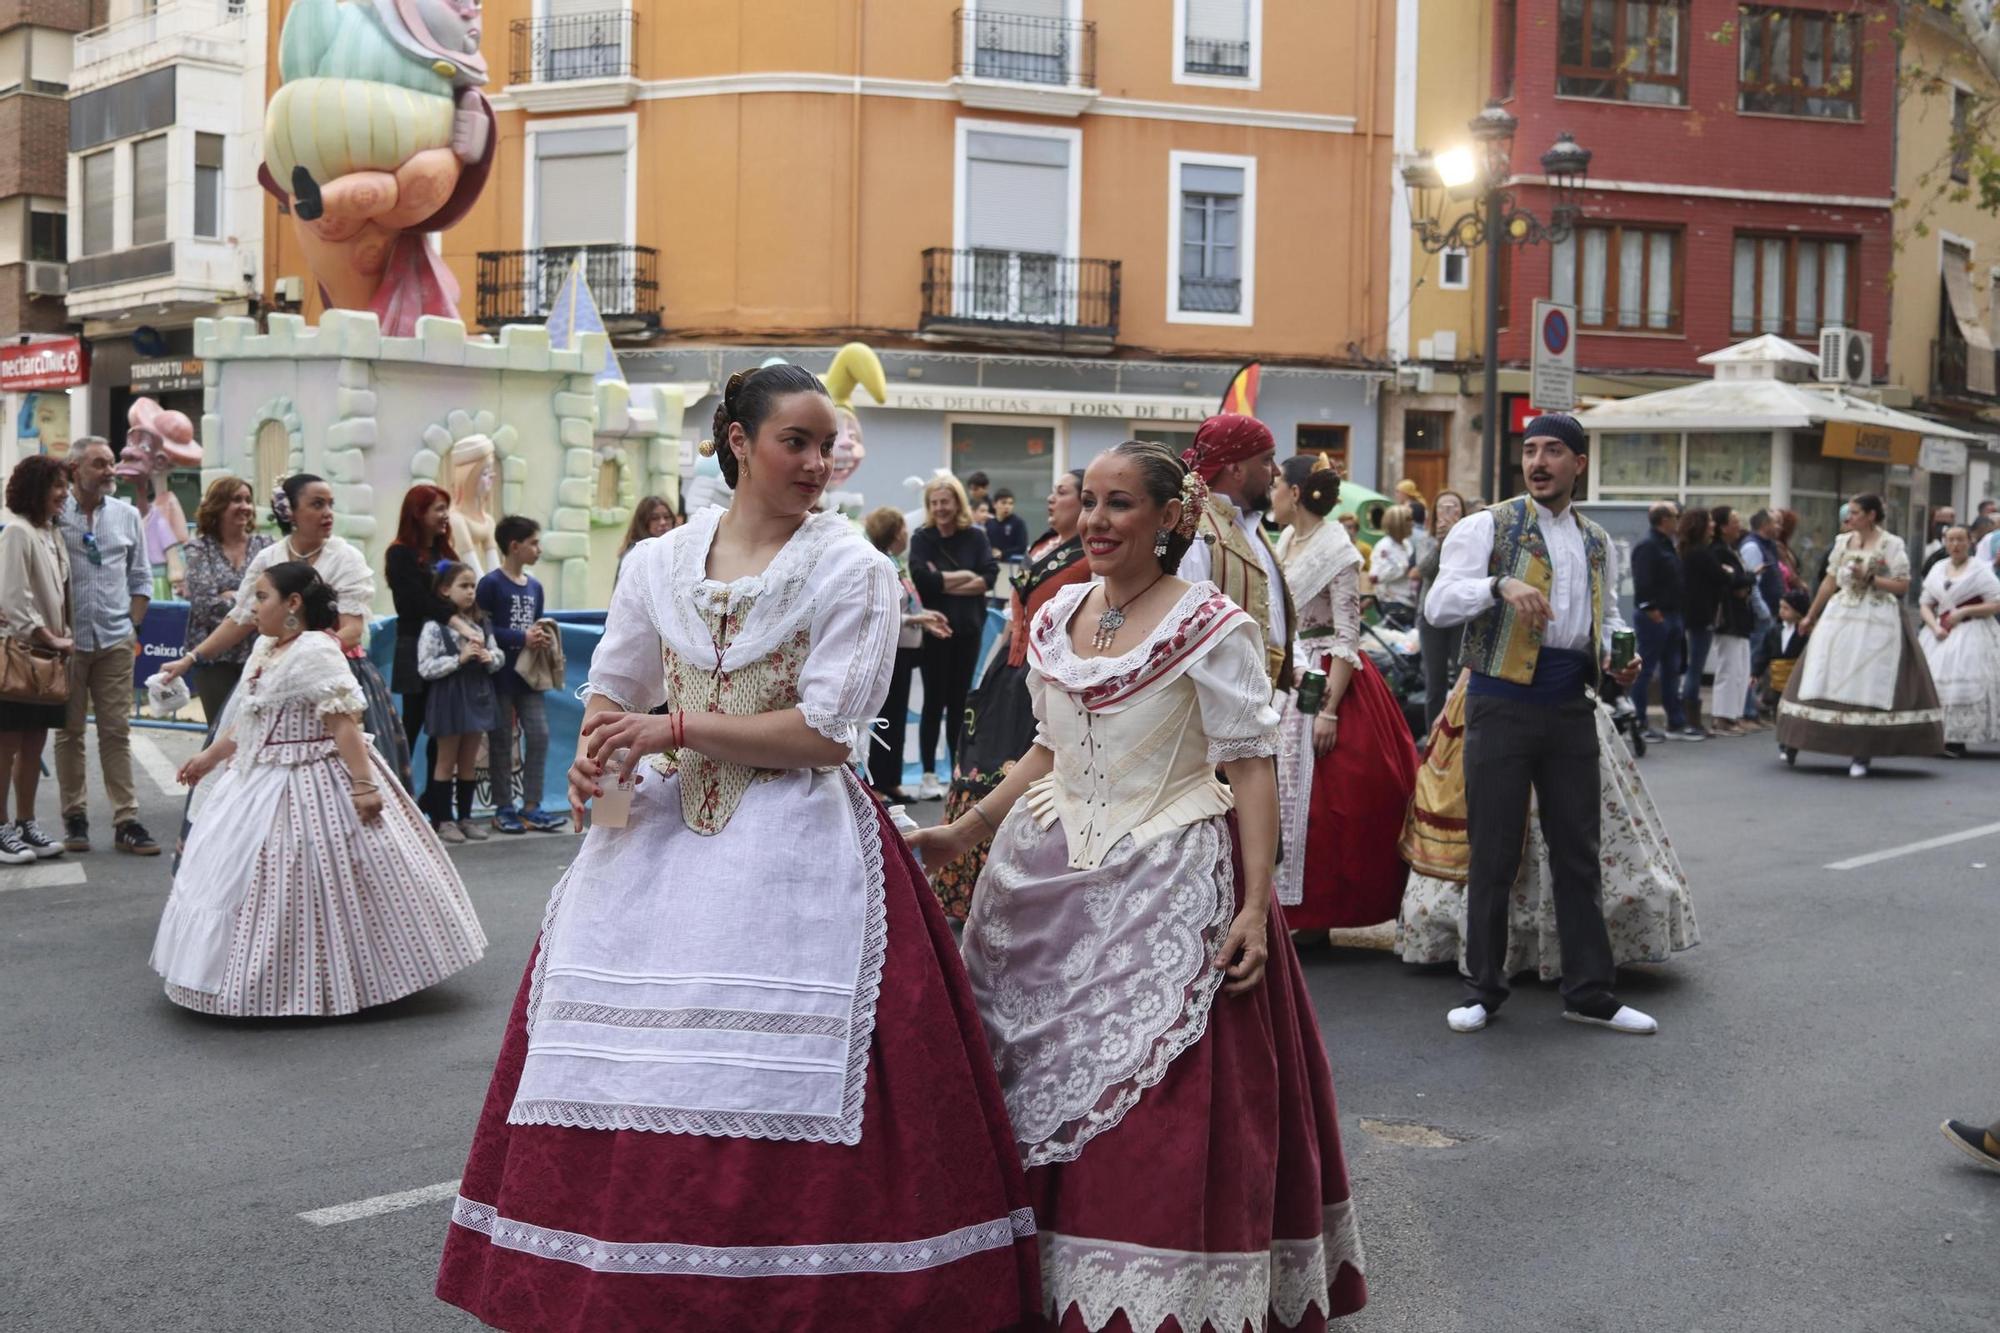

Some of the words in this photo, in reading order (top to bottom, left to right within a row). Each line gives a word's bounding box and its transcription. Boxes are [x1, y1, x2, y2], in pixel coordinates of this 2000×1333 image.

[131, 362, 170, 379] TENEMOS
[171, 361, 182, 377] TU
[896, 395, 934, 410] LAS
[943, 396, 1030, 412] DELICIAS
[1070, 402, 1122, 416] FORN
[1135, 404, 1160, 418] DE
[143, 643, 177, 658] Caixa
